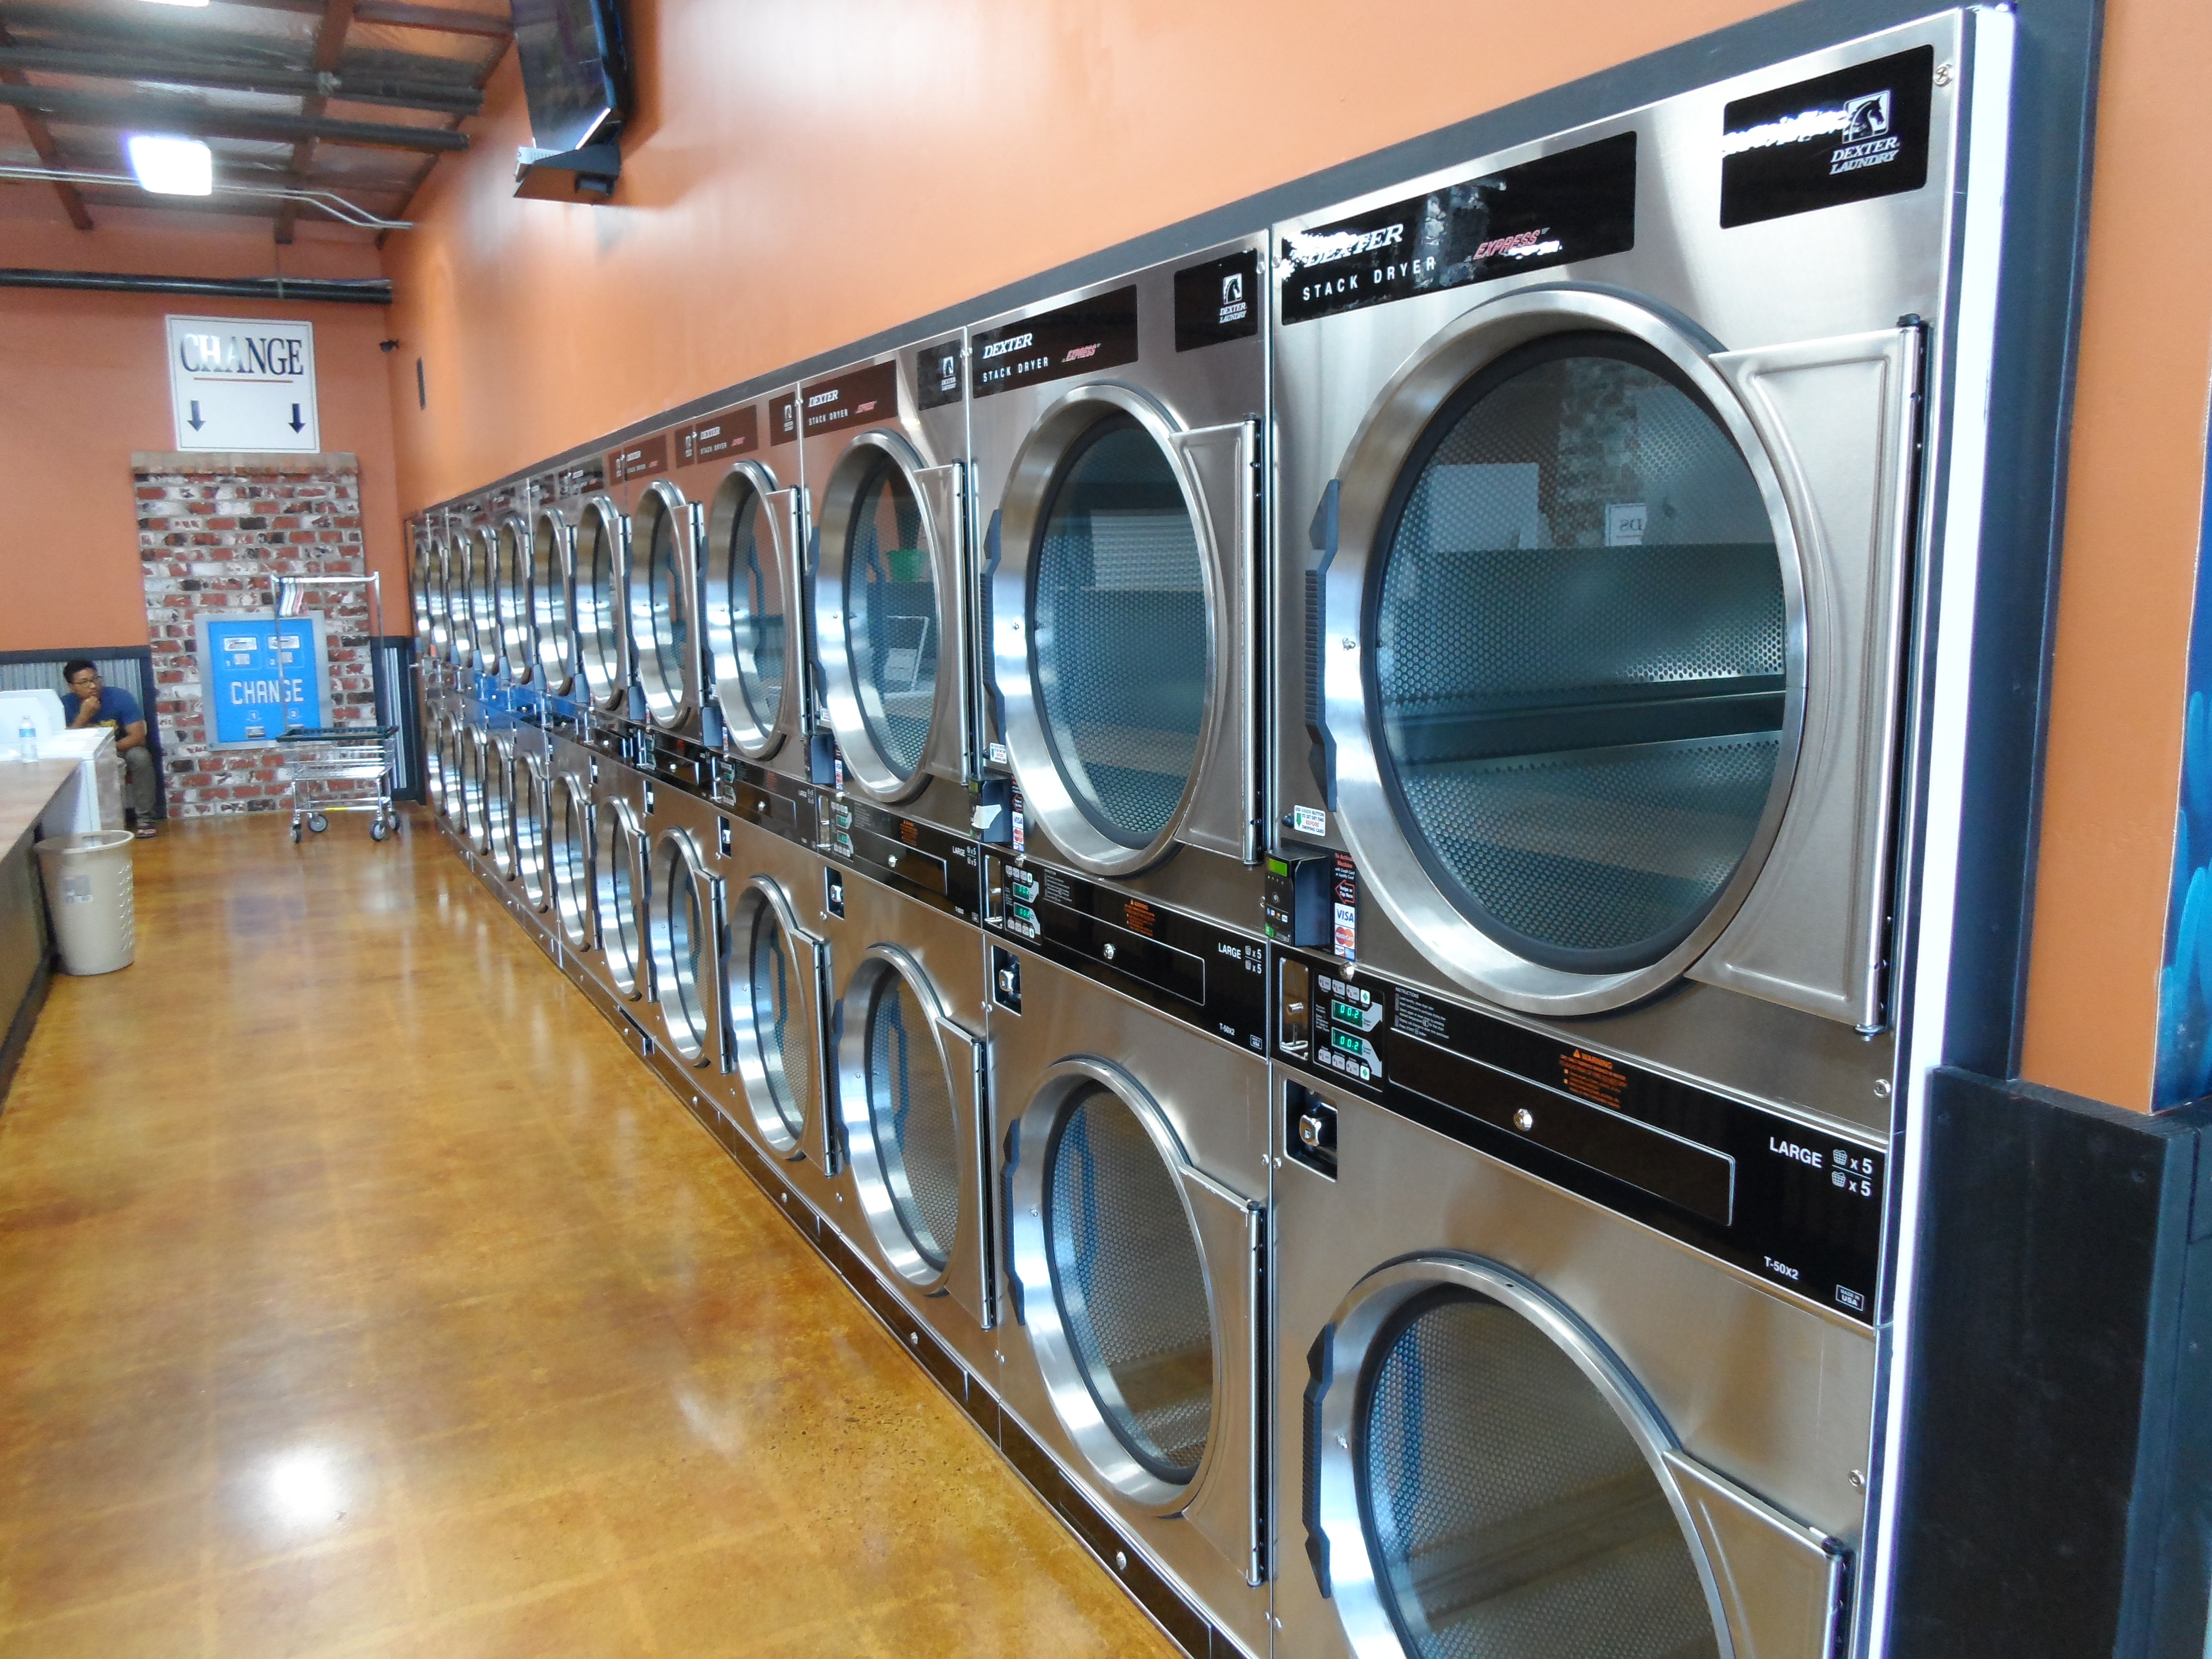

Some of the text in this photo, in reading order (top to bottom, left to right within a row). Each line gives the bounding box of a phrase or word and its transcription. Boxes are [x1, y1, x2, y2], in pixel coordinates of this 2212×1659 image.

[1830, 136, 1898, 163] DEXTER
[1829, 149, 1899, 175] LAUNDRY
[1473, 229, 1540, 260] EXPRESS
[1303, 256, 1436, 301] STACK DRYER
[1220, 302, 1246, 316] DEXTER
[180, 334, 304, 375] CHANGE
[983, 333, 1033, 359] DEXTER
[983, 357, 1048, 382] STACK DRYER
[808, 389, 839, 407] DEXTER
[809, 415, 826, 426] STACK
[231, 679, 304, 705] CHANGE
[952, 846, 965, 857] LARGE
[1336, 908, 1354, 923] VISA
[1218, 942, 1241, 960] LARGE
[1257, 949, 1262, 959] 5
[1257, 963, 1262, 974] 5
[1769, 1136, 1823, 1168] LARGE
[1862, 1157, 1872, 1175] 5
[1861, 1180, 1871, 1197] 5
[1764, 1256, 1799, 1280] T-50X2
[1841, 1294, 1858, 1306] USA
